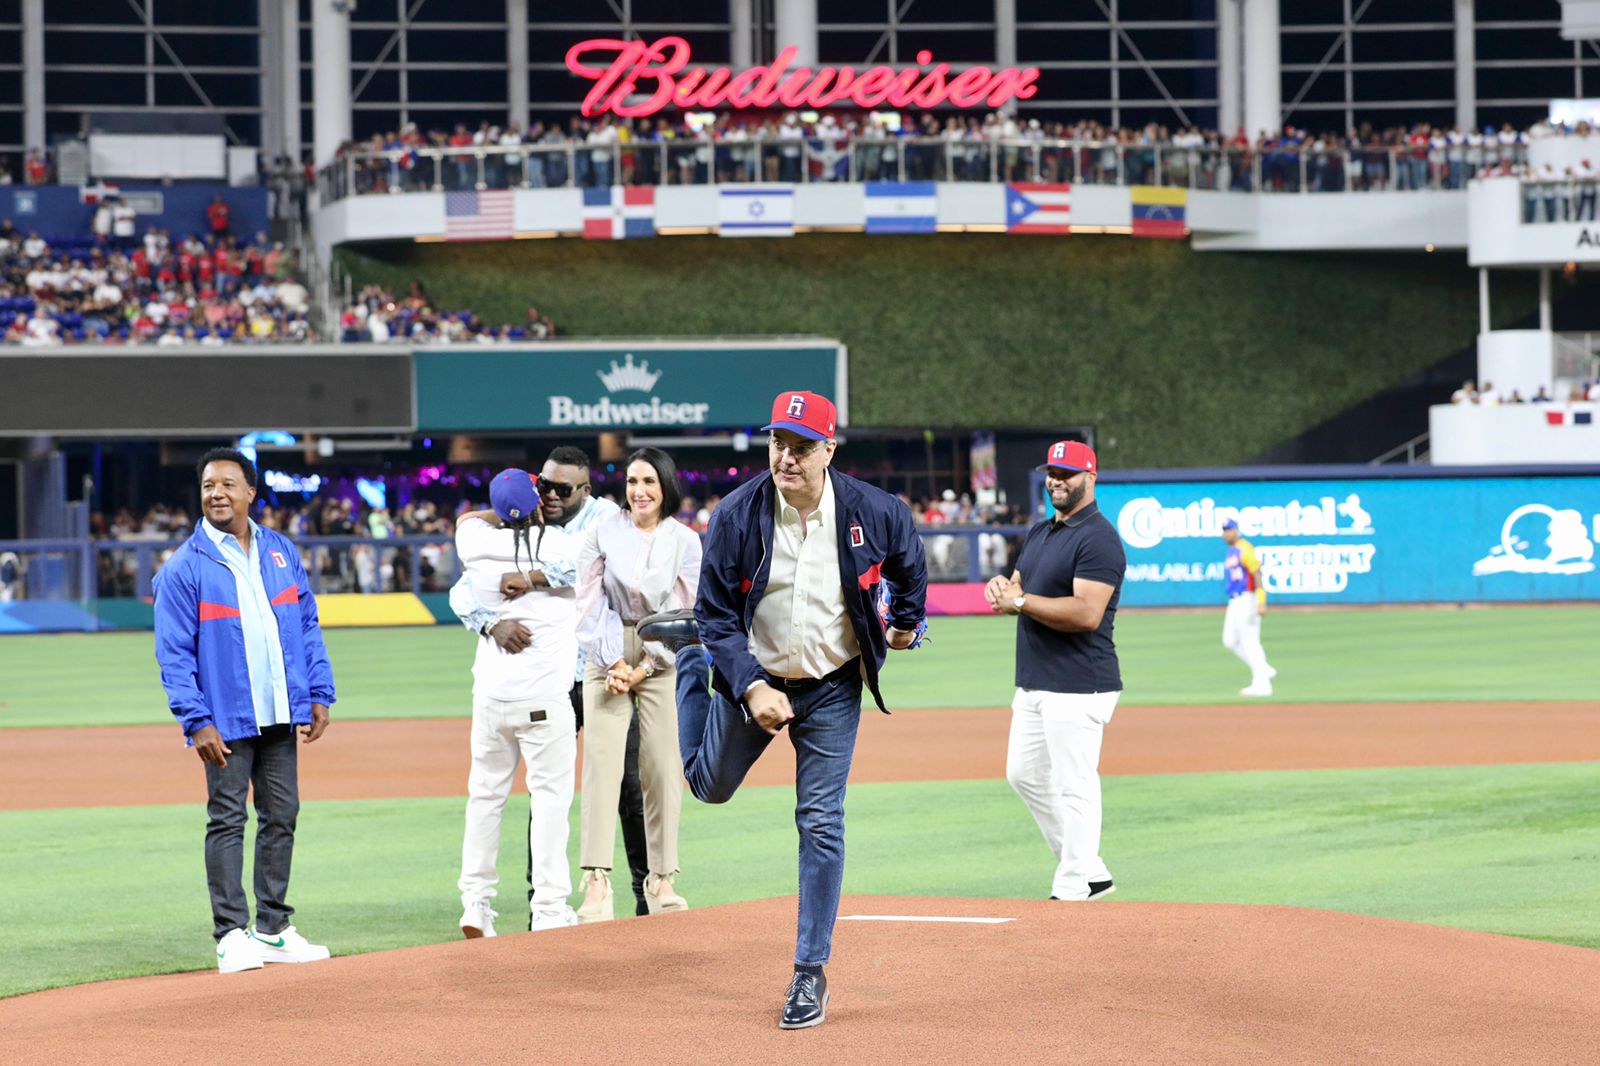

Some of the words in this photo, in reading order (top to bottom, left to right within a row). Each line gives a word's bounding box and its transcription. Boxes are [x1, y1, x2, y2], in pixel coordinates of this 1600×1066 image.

[565, 36, 1039, 118] Budweiser
[548, 395, 709, 425] Budweiser
[1117, 496, 1337, 548] Continental
[1125, 562, 1204, 581] VAILABLE
